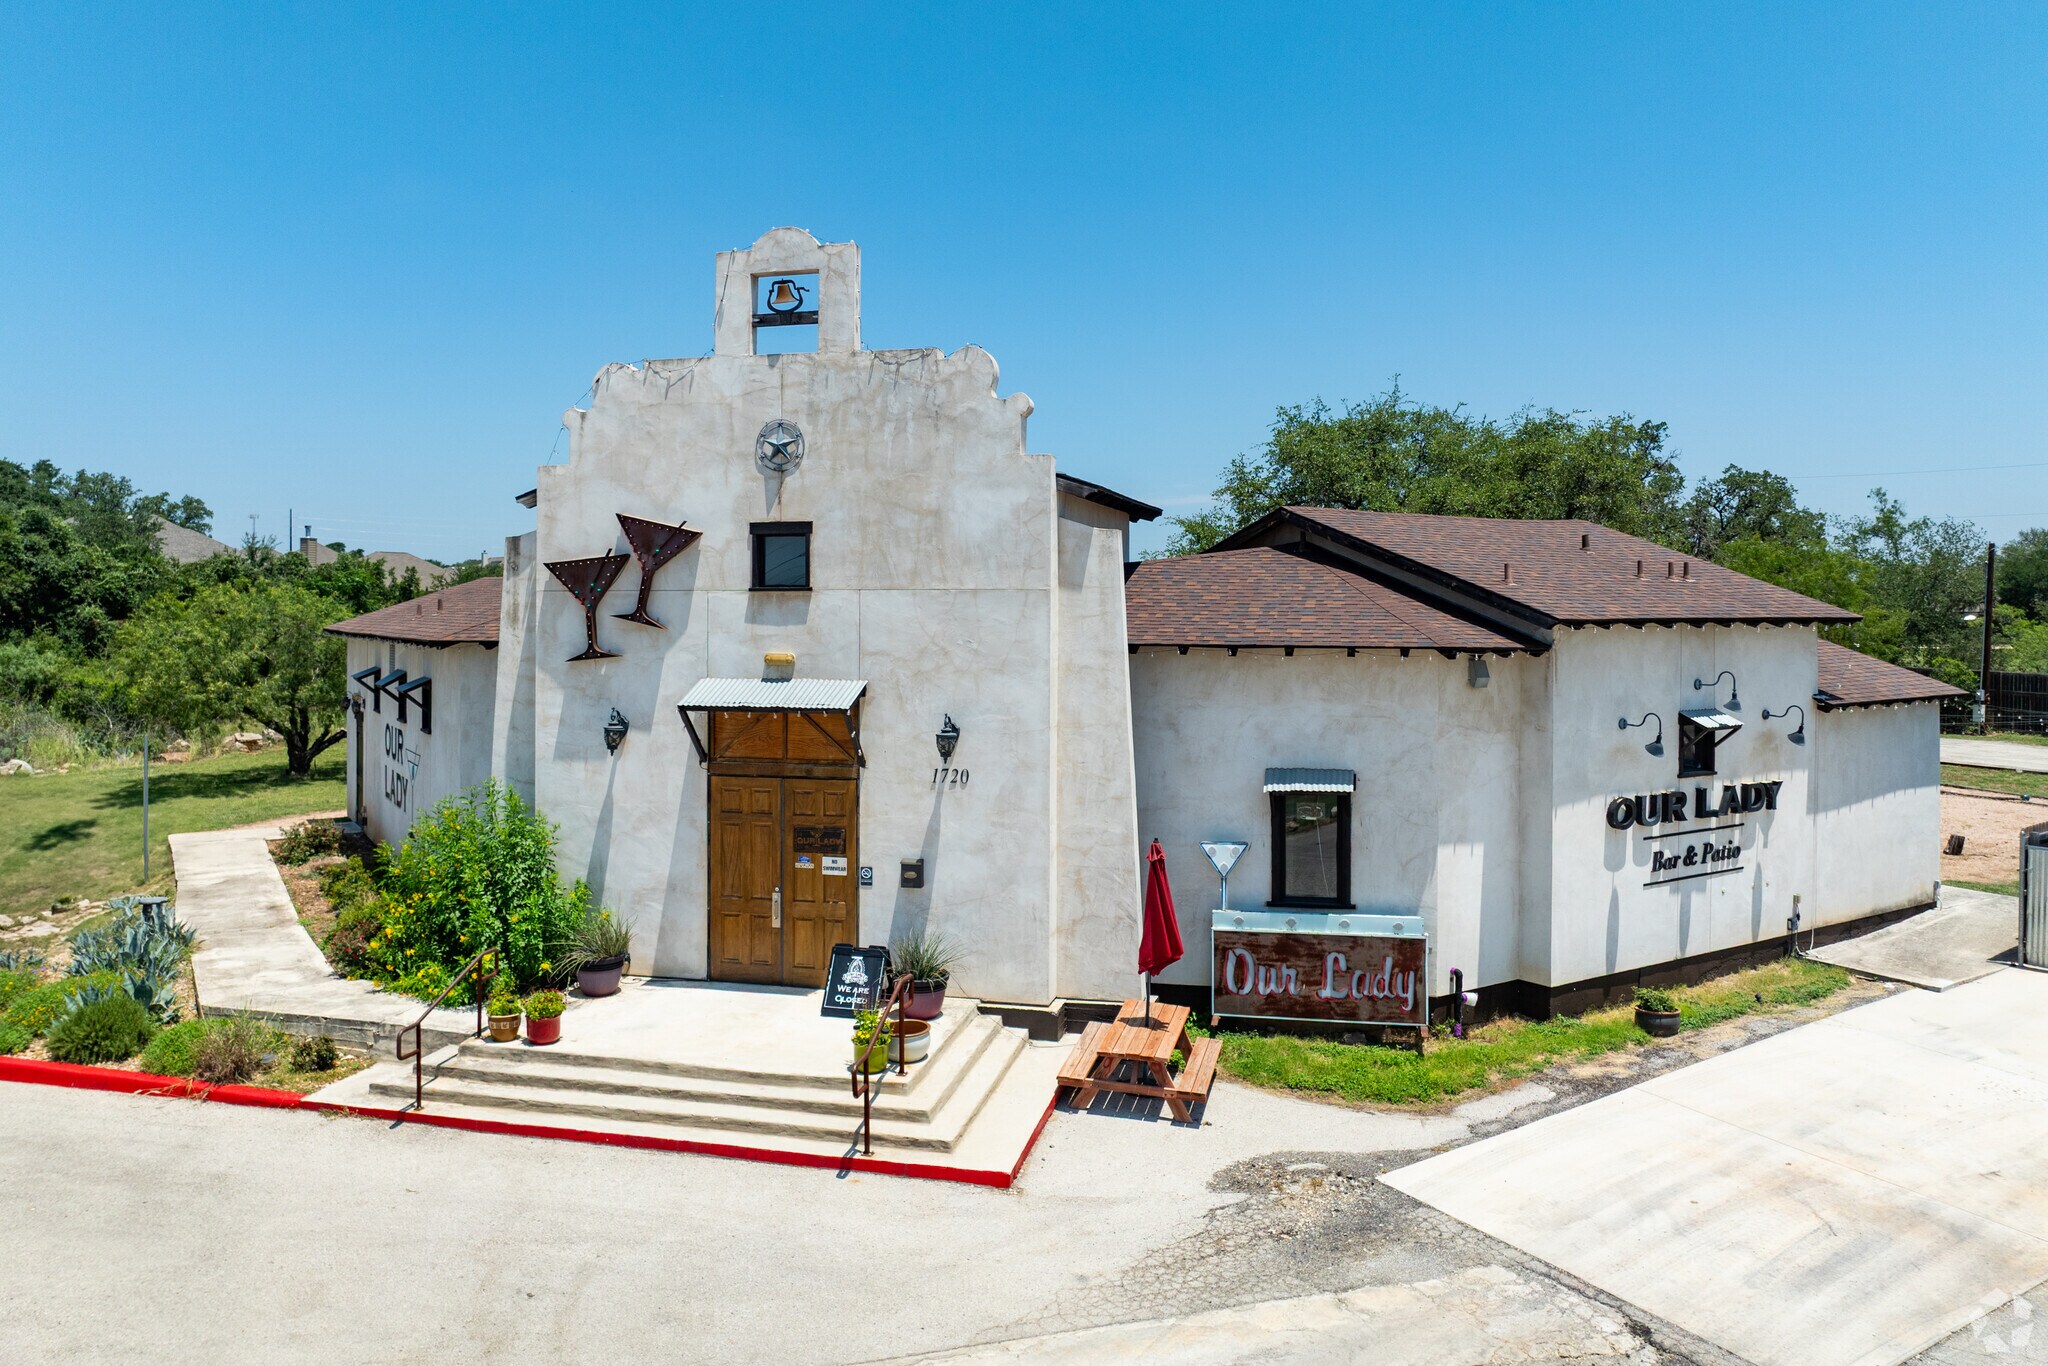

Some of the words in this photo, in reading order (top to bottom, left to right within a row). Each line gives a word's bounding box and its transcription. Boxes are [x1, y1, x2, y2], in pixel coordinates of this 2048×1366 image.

[385, 723, 403, 765] OUR
[385, 765, 408, 812] LADY
[932, 767, 970, 785] 1720
[1606, 790, 1688, 830] OUR
[1694, 779, 1783, 819] LADY
[1651, 849, 1681, 873] Bar
[1683, 844, 1697, 867] &
[1701, 840, 1742, 864] Patio
[834, 994, 868, 1005] CLOSED
[837, 984, 851, 993] WE
[852, 987, 869, 995] ARE
[1223, 948, 1298, 996] Our
[1315, 952, 1415, 1014] Lady
